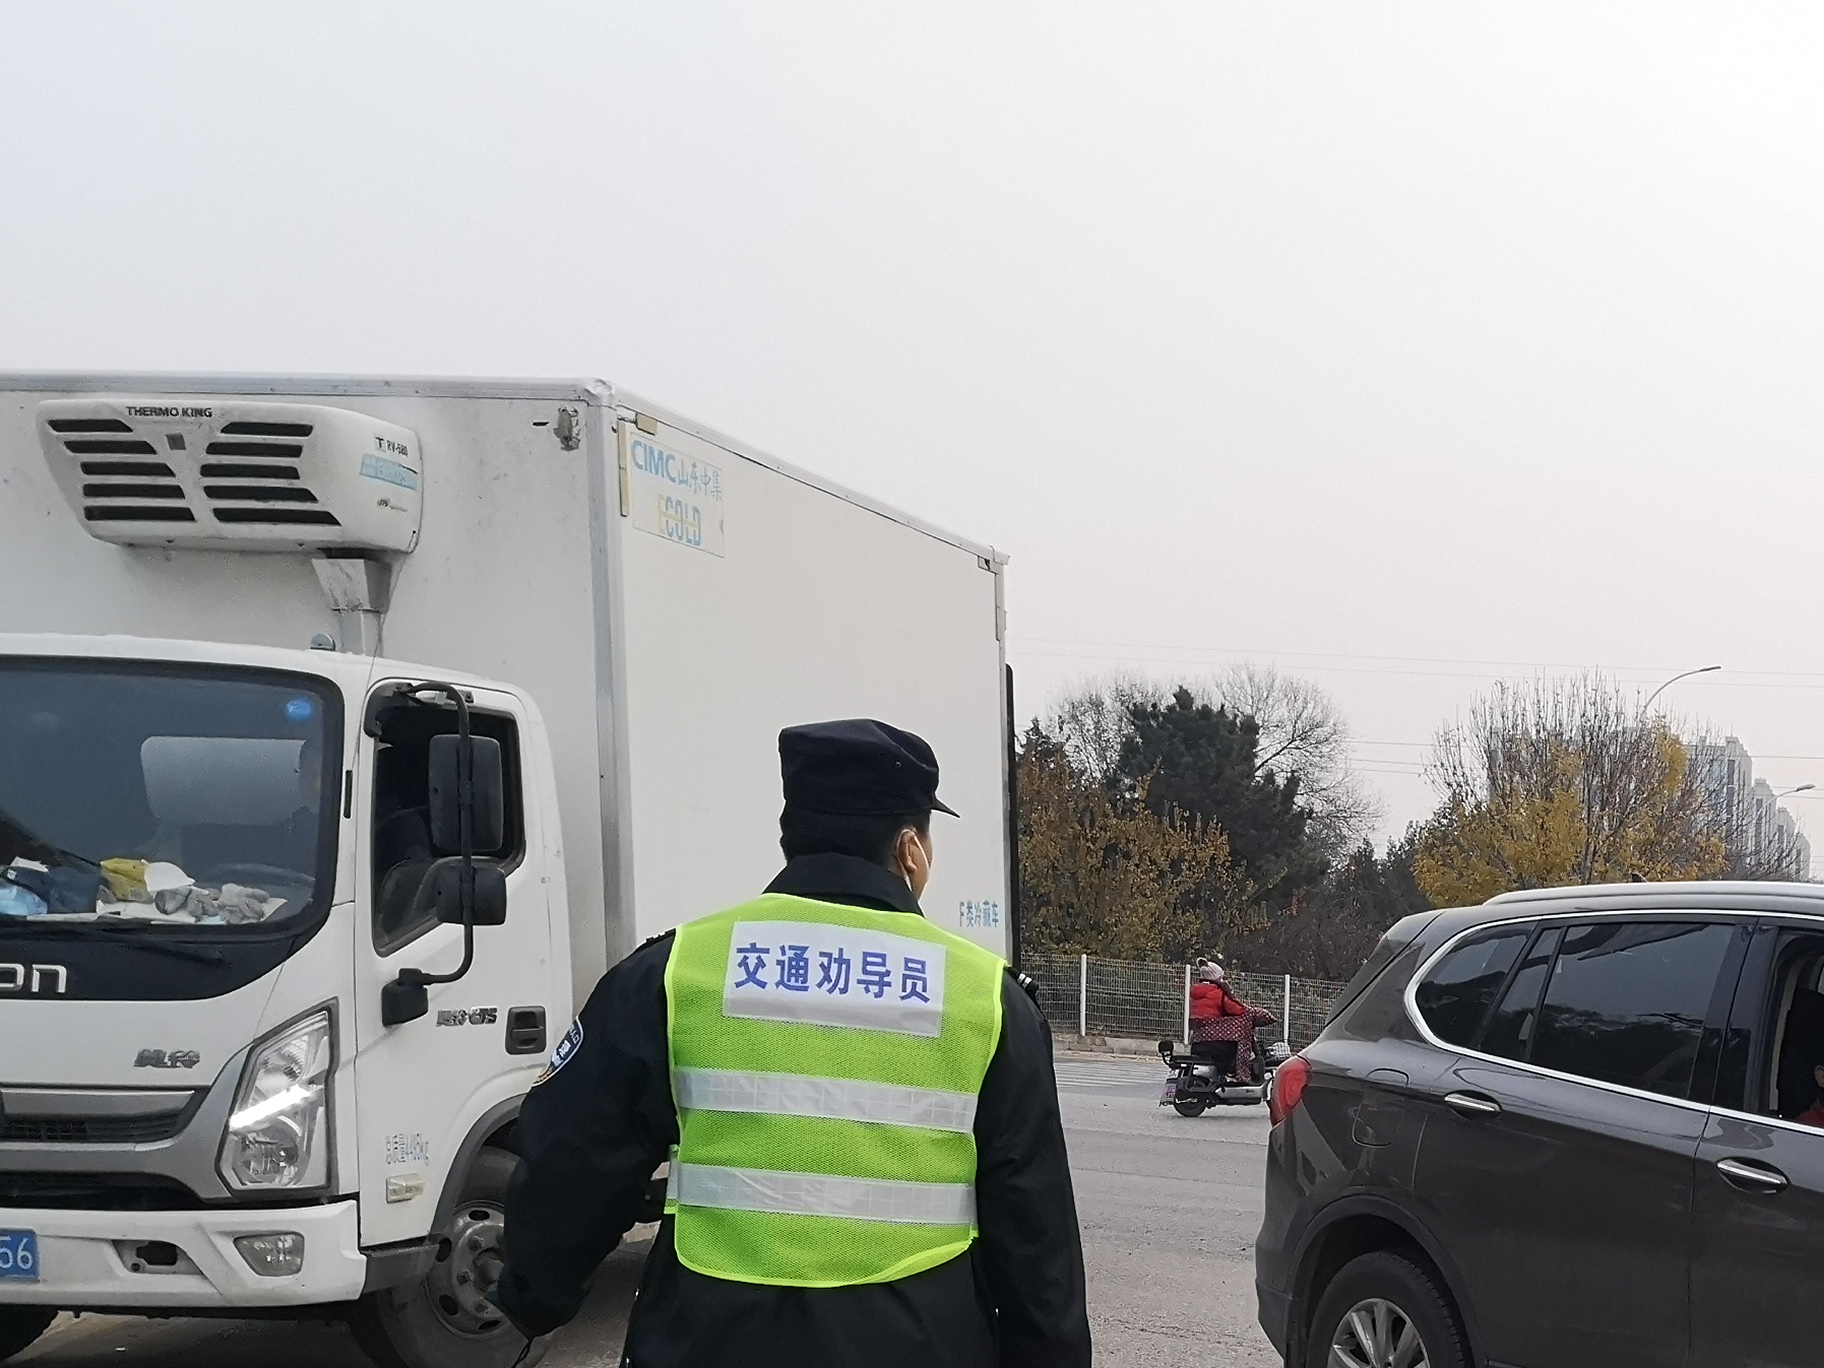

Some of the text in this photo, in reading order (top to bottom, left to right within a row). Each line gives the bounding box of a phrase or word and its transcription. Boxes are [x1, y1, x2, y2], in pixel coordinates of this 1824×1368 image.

[126, 406, 213, 418] THERMO KING
[631, 440, 676, 483] CIMC
[734, 942, 931, 1004] 交通劝导员
